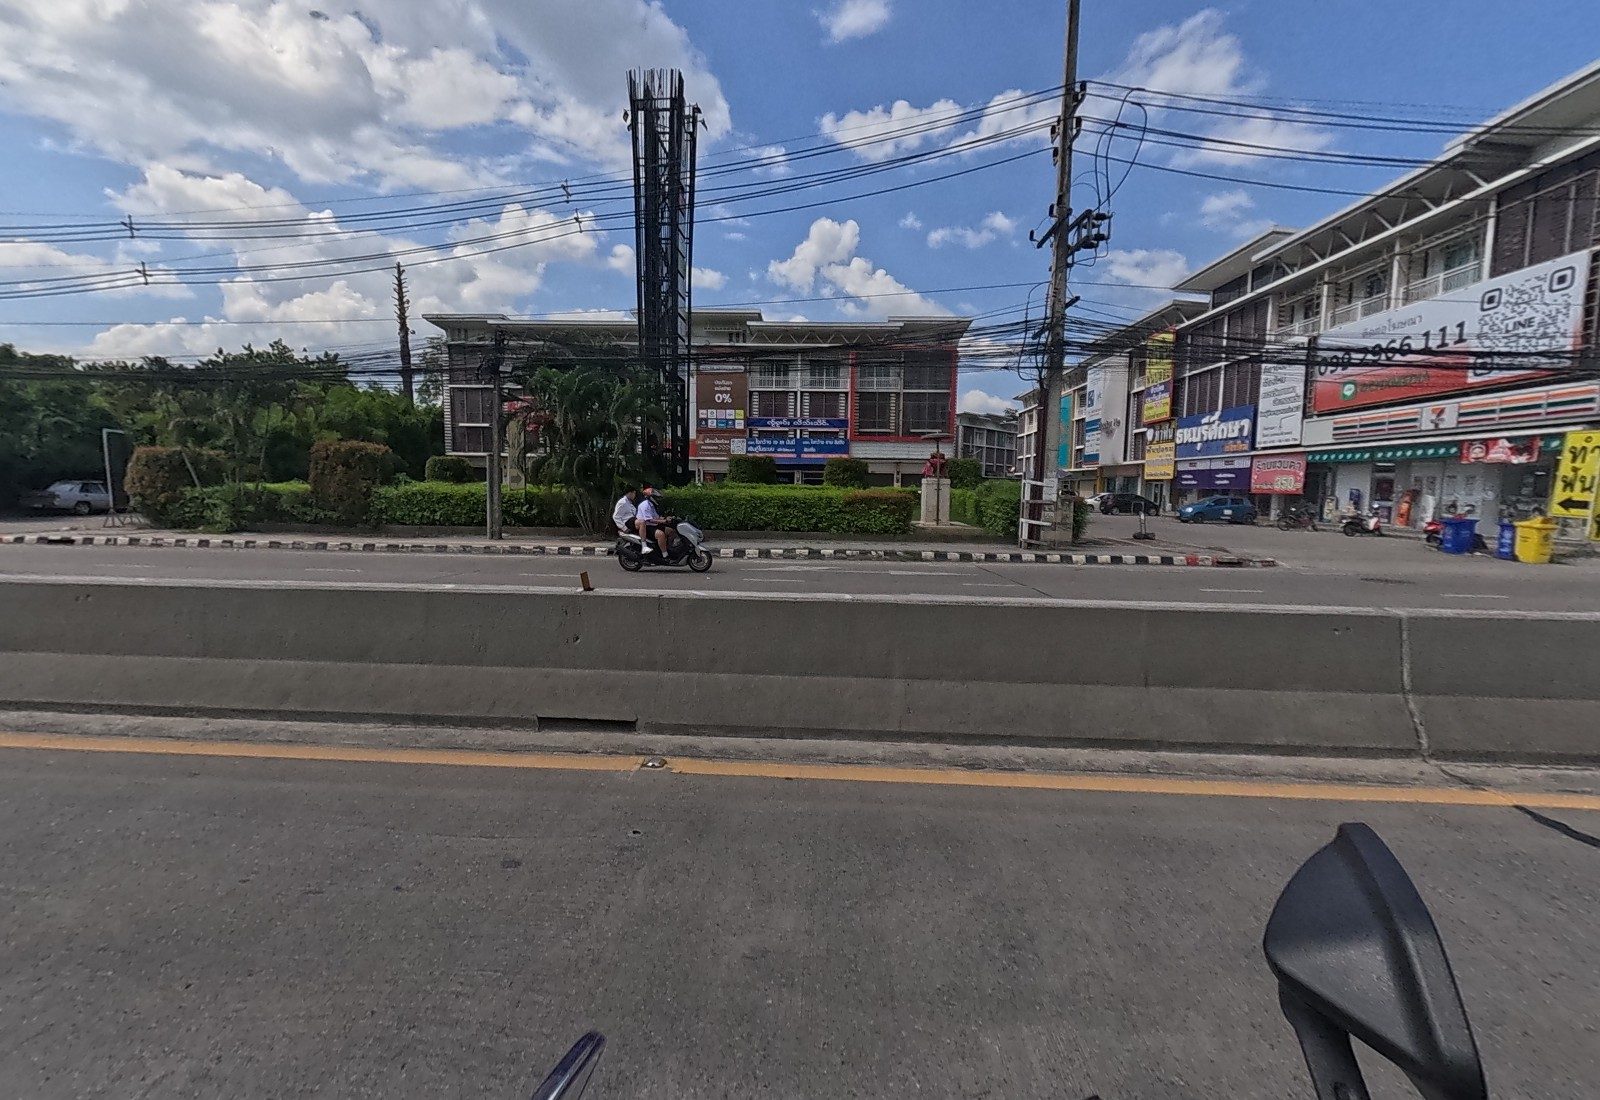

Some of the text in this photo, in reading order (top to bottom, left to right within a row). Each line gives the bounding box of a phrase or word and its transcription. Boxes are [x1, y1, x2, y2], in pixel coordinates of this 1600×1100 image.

[1505, 316, 1536, 334] LINE
[714, 393, 732, 403] 0%
[1176, 410, 1251, 451] ธนบุรีศึกษา
